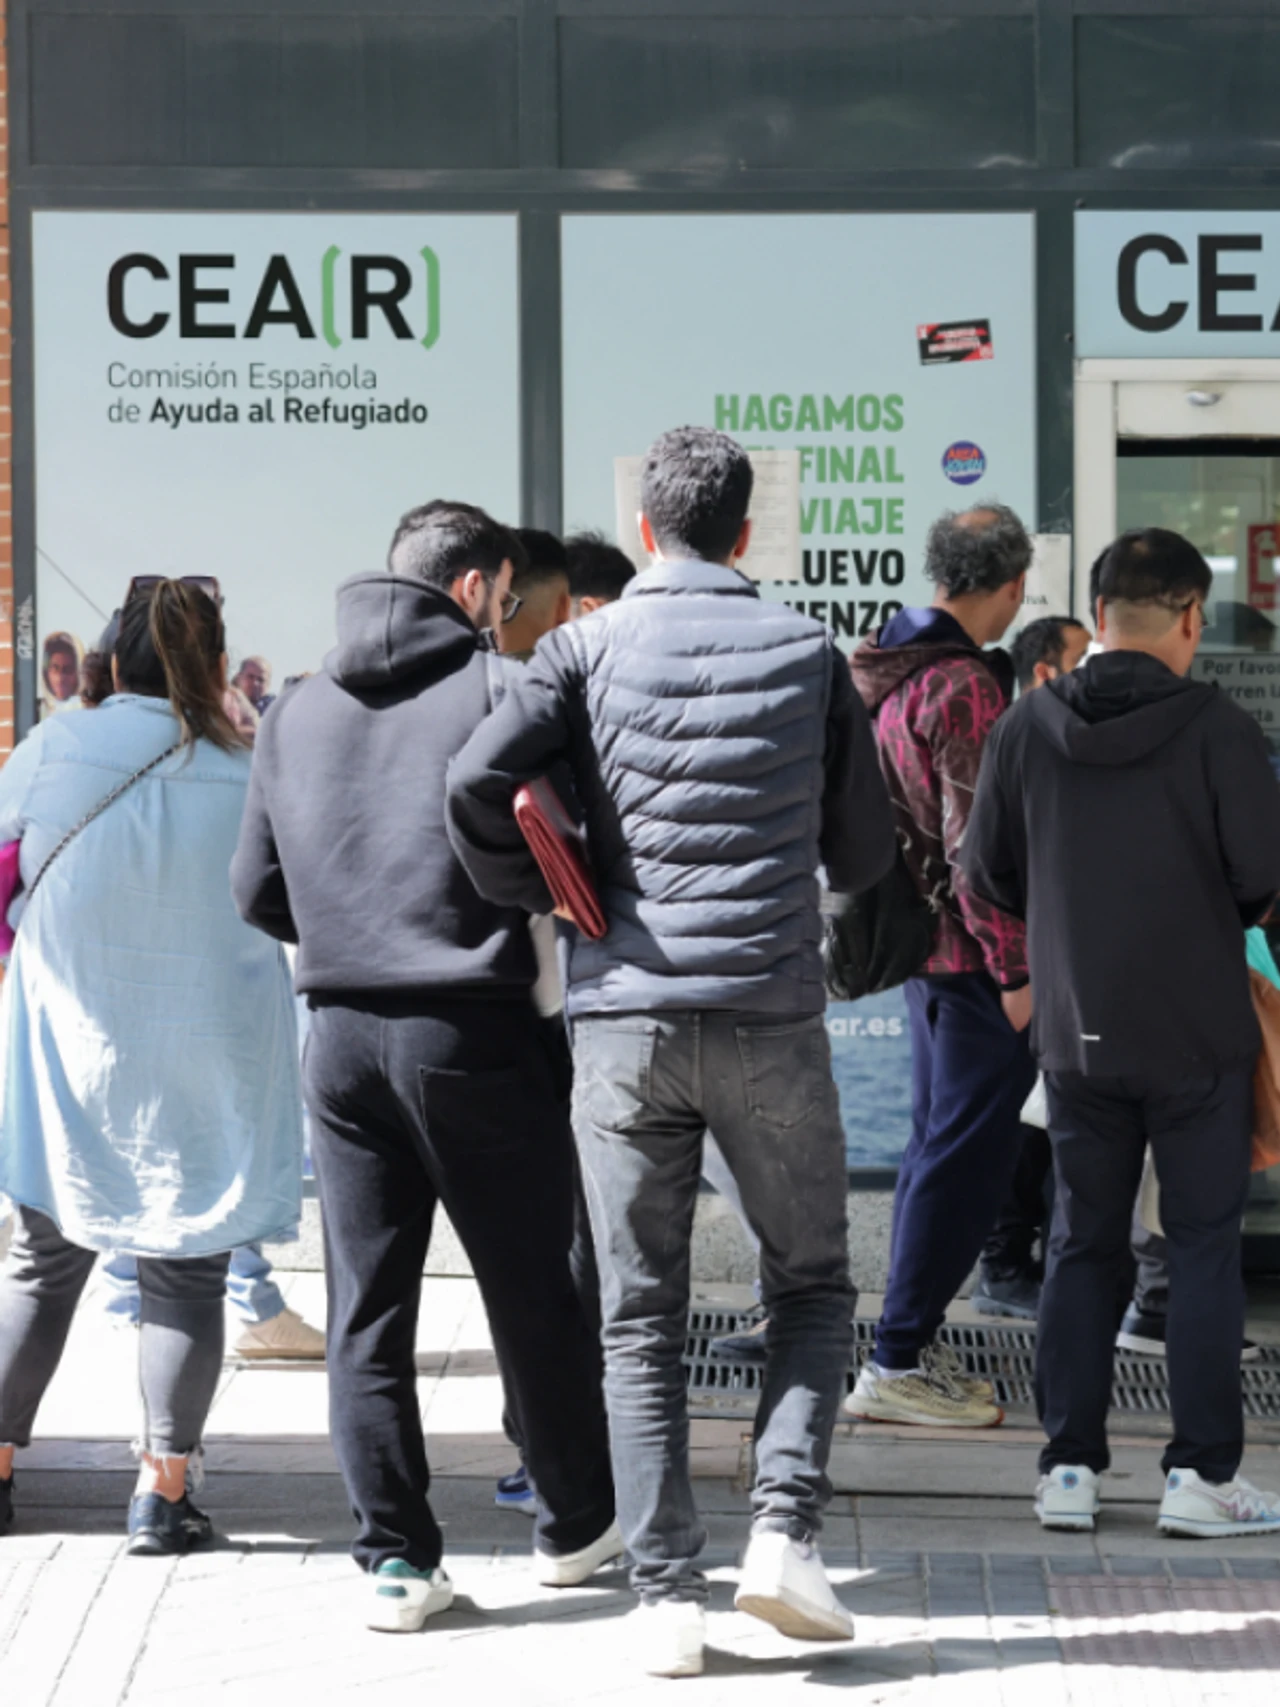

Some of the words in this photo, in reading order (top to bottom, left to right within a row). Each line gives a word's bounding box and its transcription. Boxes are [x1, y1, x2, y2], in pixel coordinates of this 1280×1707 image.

[107, 244, 440, 350] CEA(R)
[107, 361, 238, 390] Comisión
[248, 362, 378, 395] Española
[107, 399, 141, 424] de
[149, 398, 239, 430] Ayuda
[248, 398, 275, 424] al
[284, 398, 428, 430] Refugiado
[714, 393, 904, 432] HAGAMOS
[795, 445, 904, 484] FINAL
[799, 497, 904, 535] VIAJE
[774, 548, 905, 586] UEVO
[1202, 659, 1233, 675] Por
[1226, 683, 1266, 699] rren
[827, 1016, 904, 1037] ar.es
